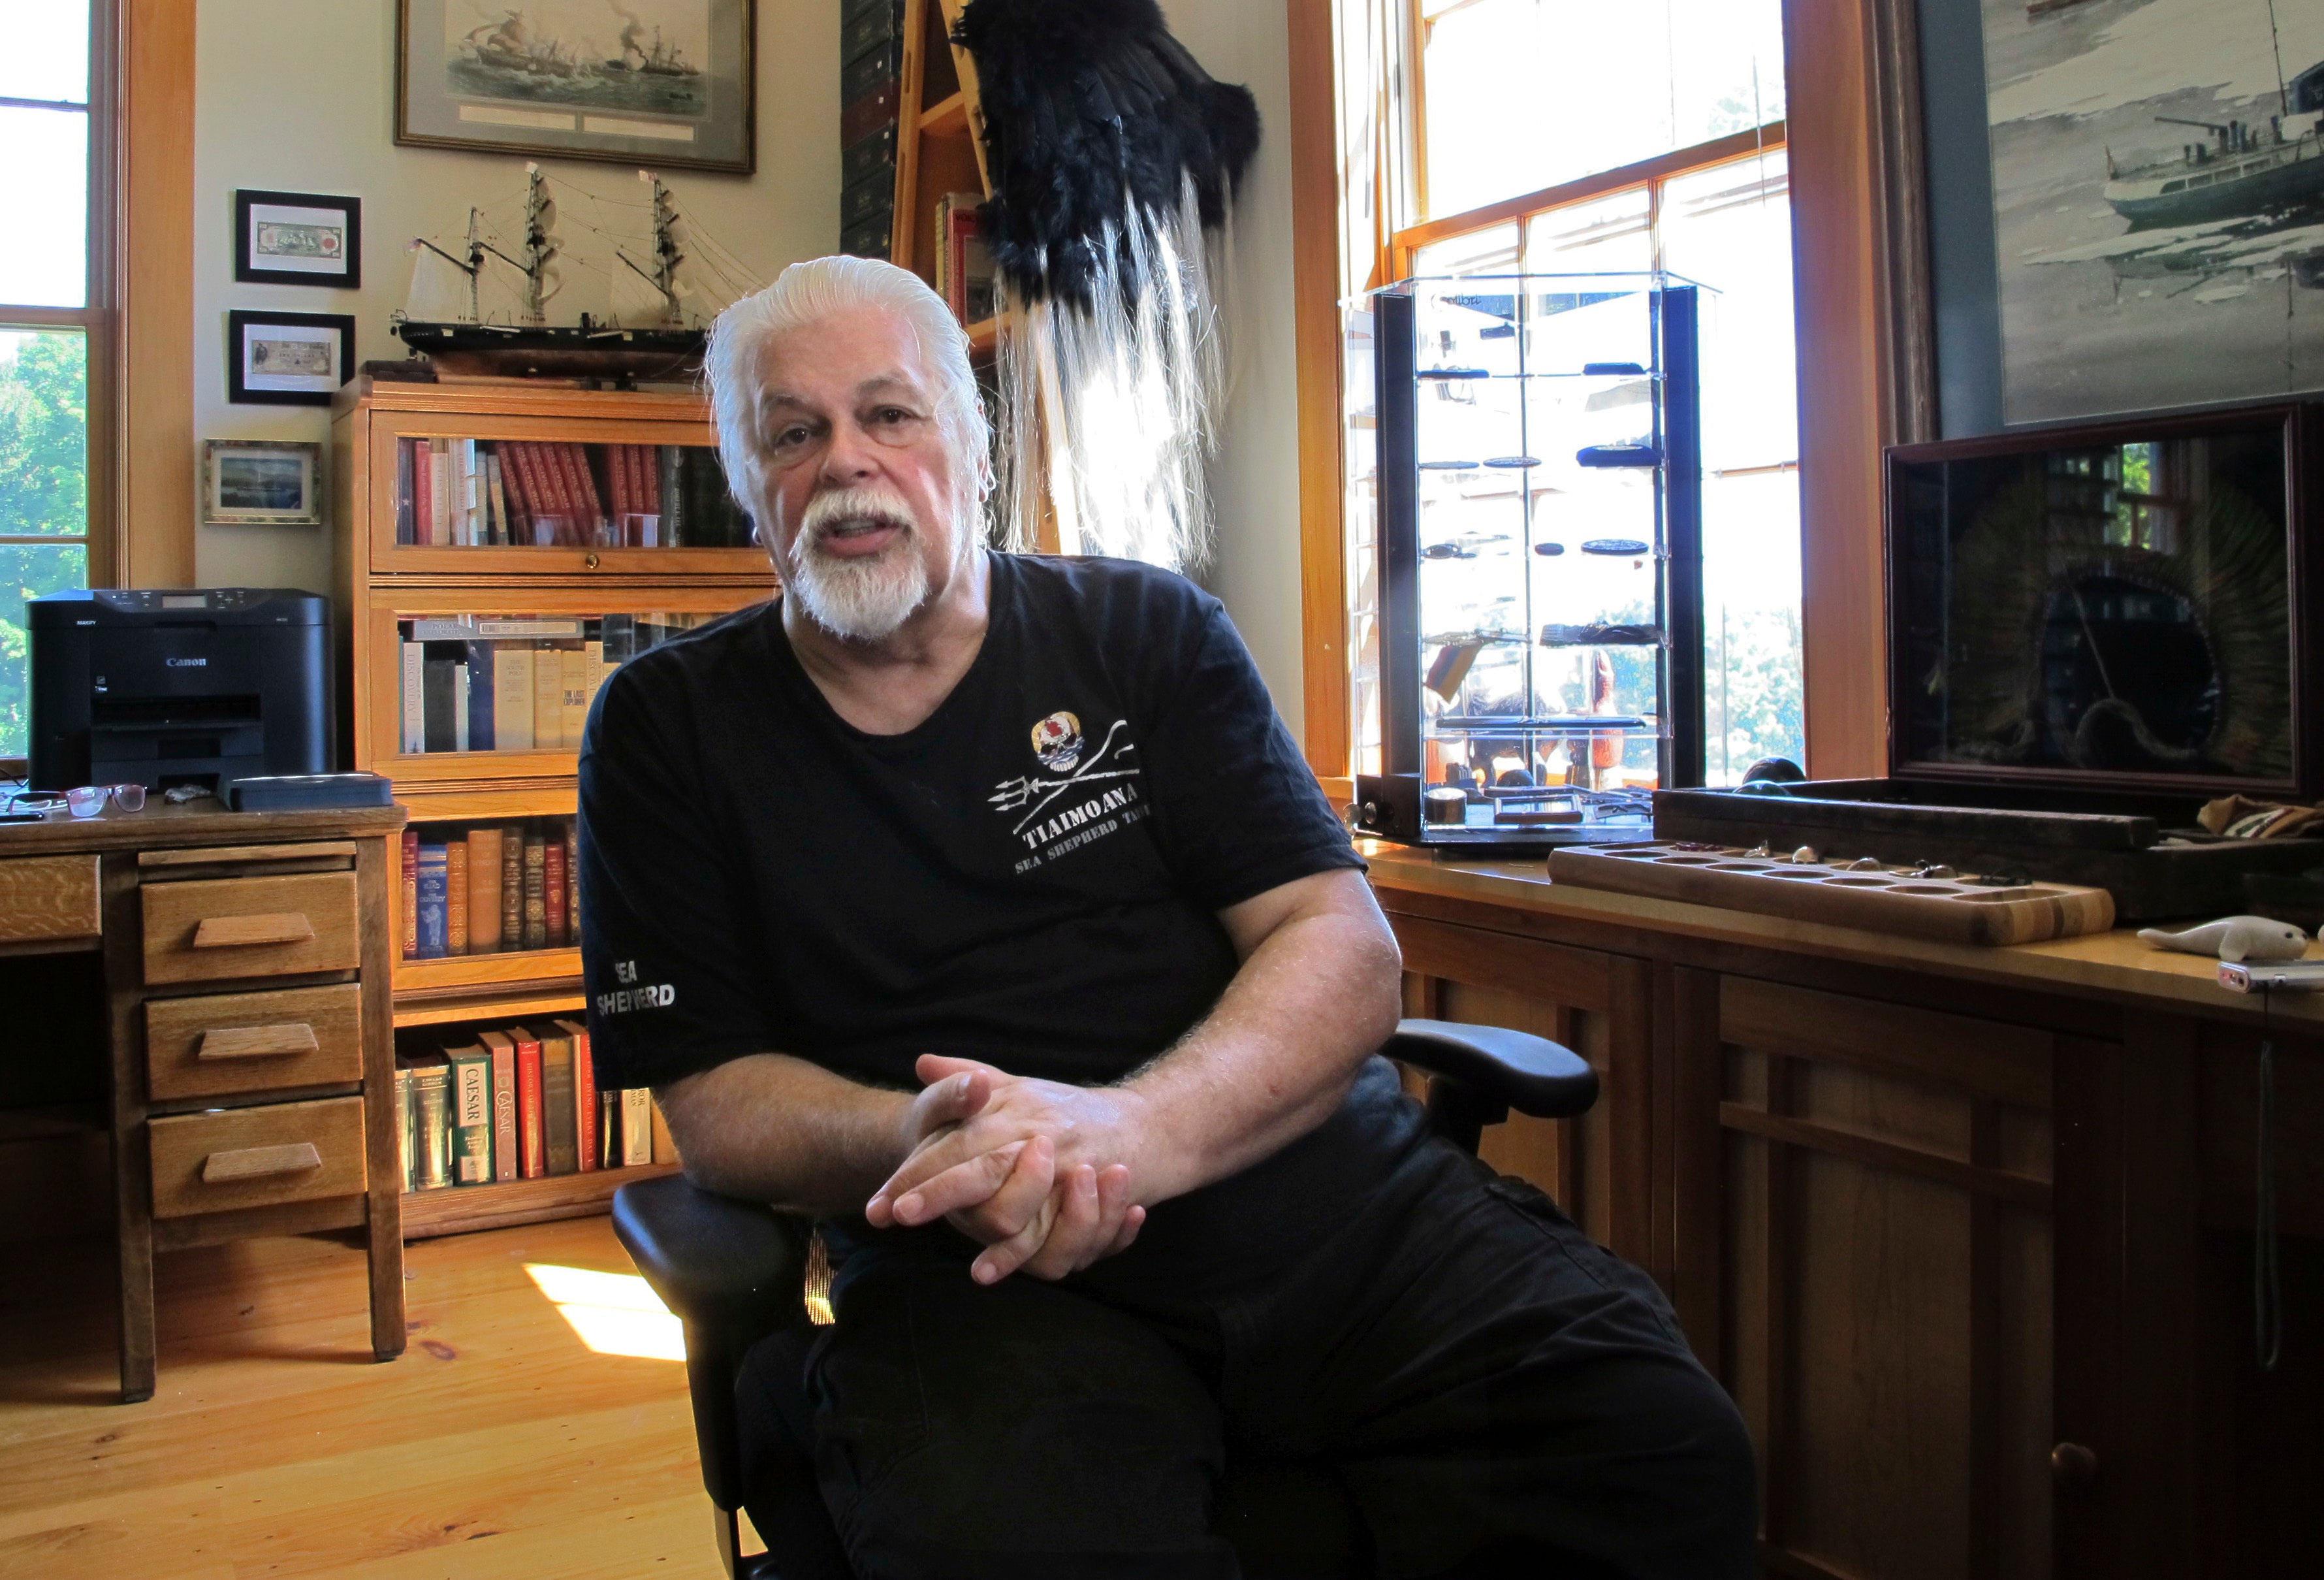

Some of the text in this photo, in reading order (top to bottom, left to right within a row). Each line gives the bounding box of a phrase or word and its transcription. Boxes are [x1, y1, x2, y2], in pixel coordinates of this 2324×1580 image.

[525, 466, 535, 487] CIVIL
[532, 491, 541, 509] WAR
[539, 465, 549, 487] CIVIL
[546, 490, 556, 508] WAR
[554, 465, 564, 487] CIVIL
[562, 491, 571, 508] WAR
[569, 466, 578, 487] CIVIL
[576, 490, 585, 508] WAR
[584, 466, 594, 488] CIVIL
[591, 491, 599, 508] WAR
[407, 654, 415, 711] DISCOVERY
[1022, 782, 1138, 849] TIAIMOANA
[1015, 856, 1042, 874] SEA
[1047, 819, 1118, 860] SHEPHERD
[466, 1069, 480, 1121] CAESAR
[496, 1091, 513, 1135] CAESAR
